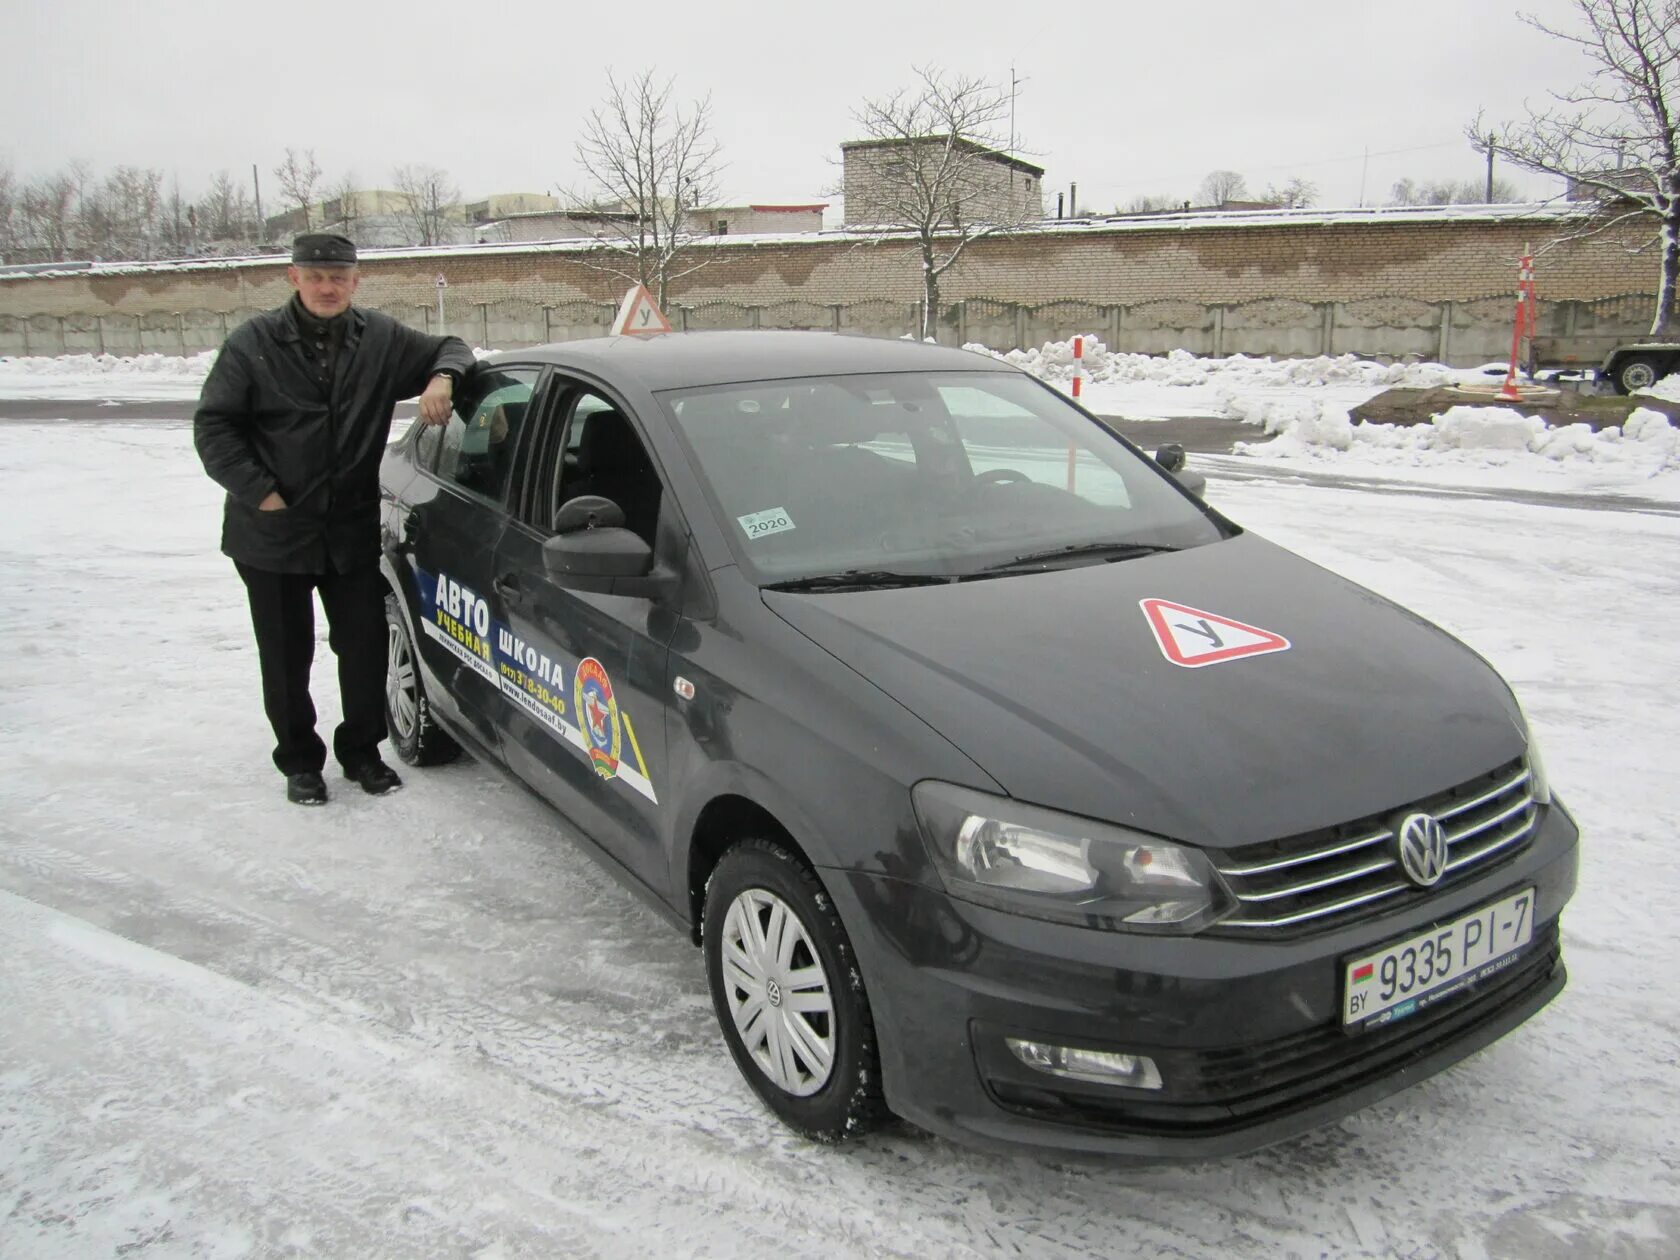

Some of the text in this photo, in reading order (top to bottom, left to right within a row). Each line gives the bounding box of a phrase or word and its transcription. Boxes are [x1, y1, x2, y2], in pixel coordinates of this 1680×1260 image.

[640, 309, 651, 327] У
[749, 518, 787, 533] 2020
[436, 573, 564, 692] АВТО ШКОЛА
[437, 609, 490, 662] УЧЕБНАЯ
[1174, 620, 1224, 648] У
[501, 662, 516, 682] (017)
[503, 681, 568, 736] www.lendosaaf.by
[1380, 930, 1454, 1001] 9335
[1350, 991, 1369, 1015] BY
